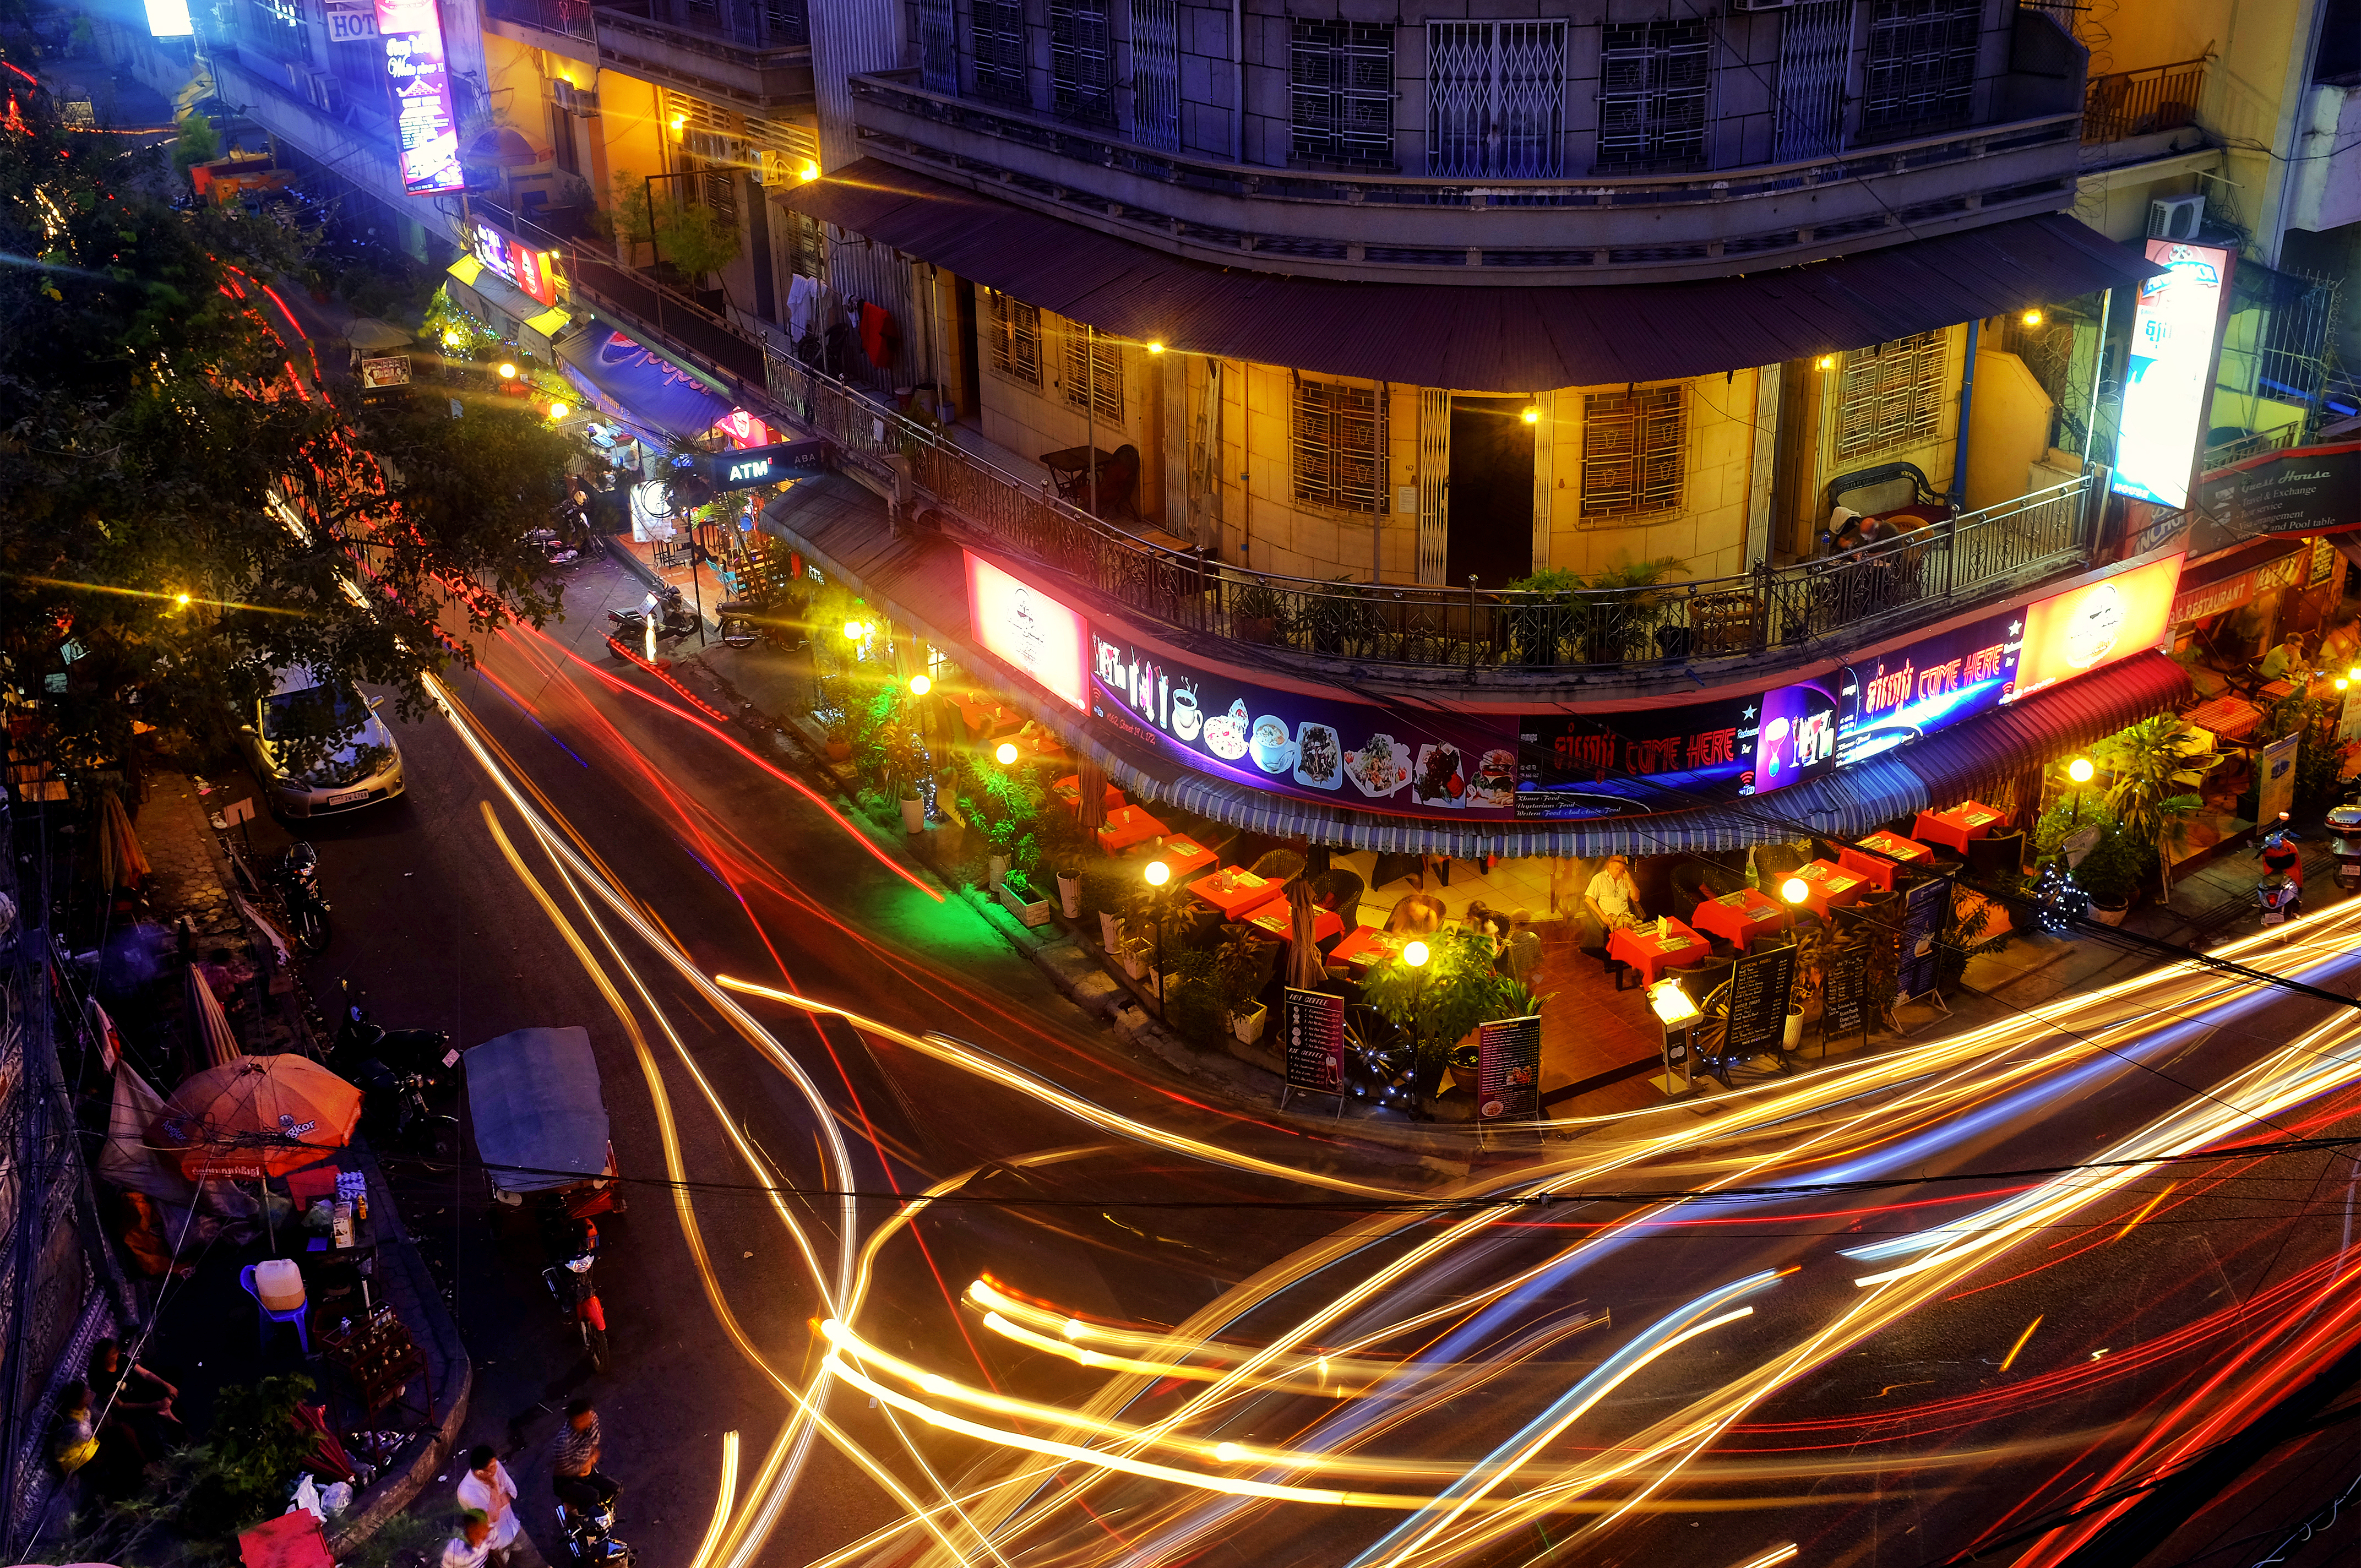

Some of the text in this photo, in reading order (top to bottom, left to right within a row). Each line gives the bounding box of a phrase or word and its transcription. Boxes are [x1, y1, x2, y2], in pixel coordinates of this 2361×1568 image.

[795, 453, 816, 464] ABA
[730, 460, 768, 482] ATM
[2278, 470, 2331, 484] House
[2264, 492, 2271, 500] &
[2273, 485, 2317, 498] Exchange
[2256, 502, 2283, 513] service
[2289, 520, 2311, 530] Pool
[2313, 516, 2335, 526] table
[2186, 583, 2246, 620] RESTAURANT
[1918, 643, 2004, 702] COME HERE
[1625, 727, 1737, 775] COME HERE
[1304, 996, 1330, 1007] COFFEE
[1301, 1050, 1324, 1059] COFFEE
[161, 1119, 187, 1143] Angkor
[285, 1120, 315, 1139] gkor
